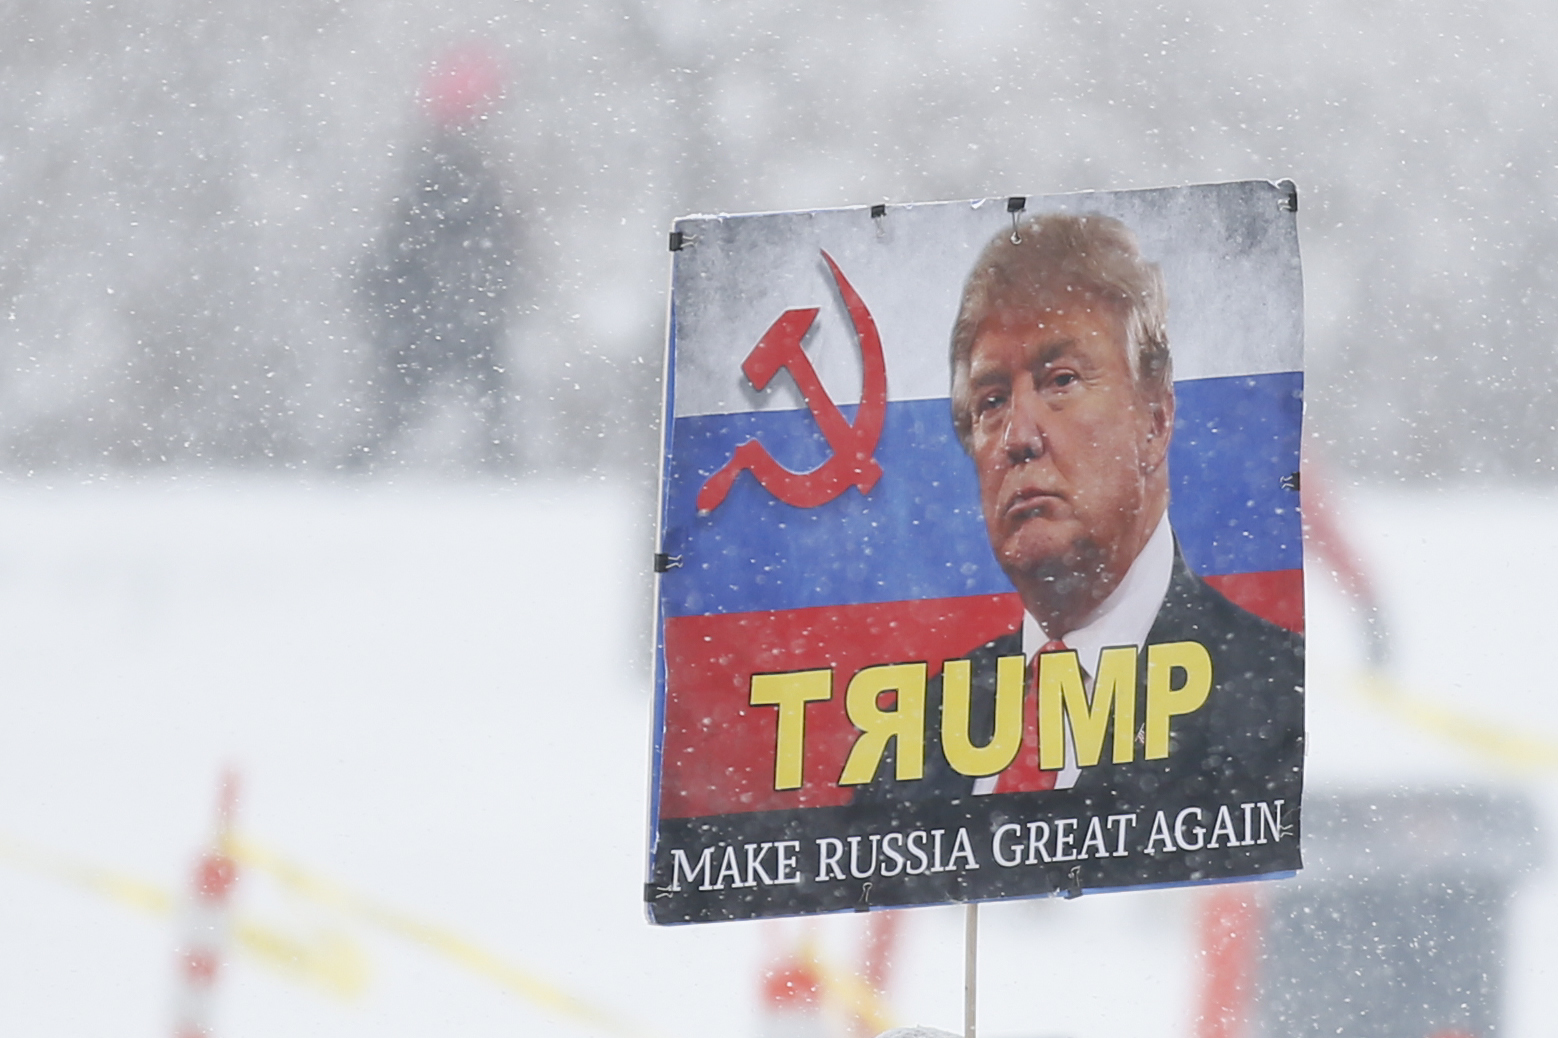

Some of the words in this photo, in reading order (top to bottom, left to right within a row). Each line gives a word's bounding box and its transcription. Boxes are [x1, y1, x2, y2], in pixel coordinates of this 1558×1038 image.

[671, 840, 802, 892] MAKE
[815, 827, 979, 882] RUSSIA
[992, 813, 1137, 867] GREAT
[1143, 799, 1285, 854] AGAIN
